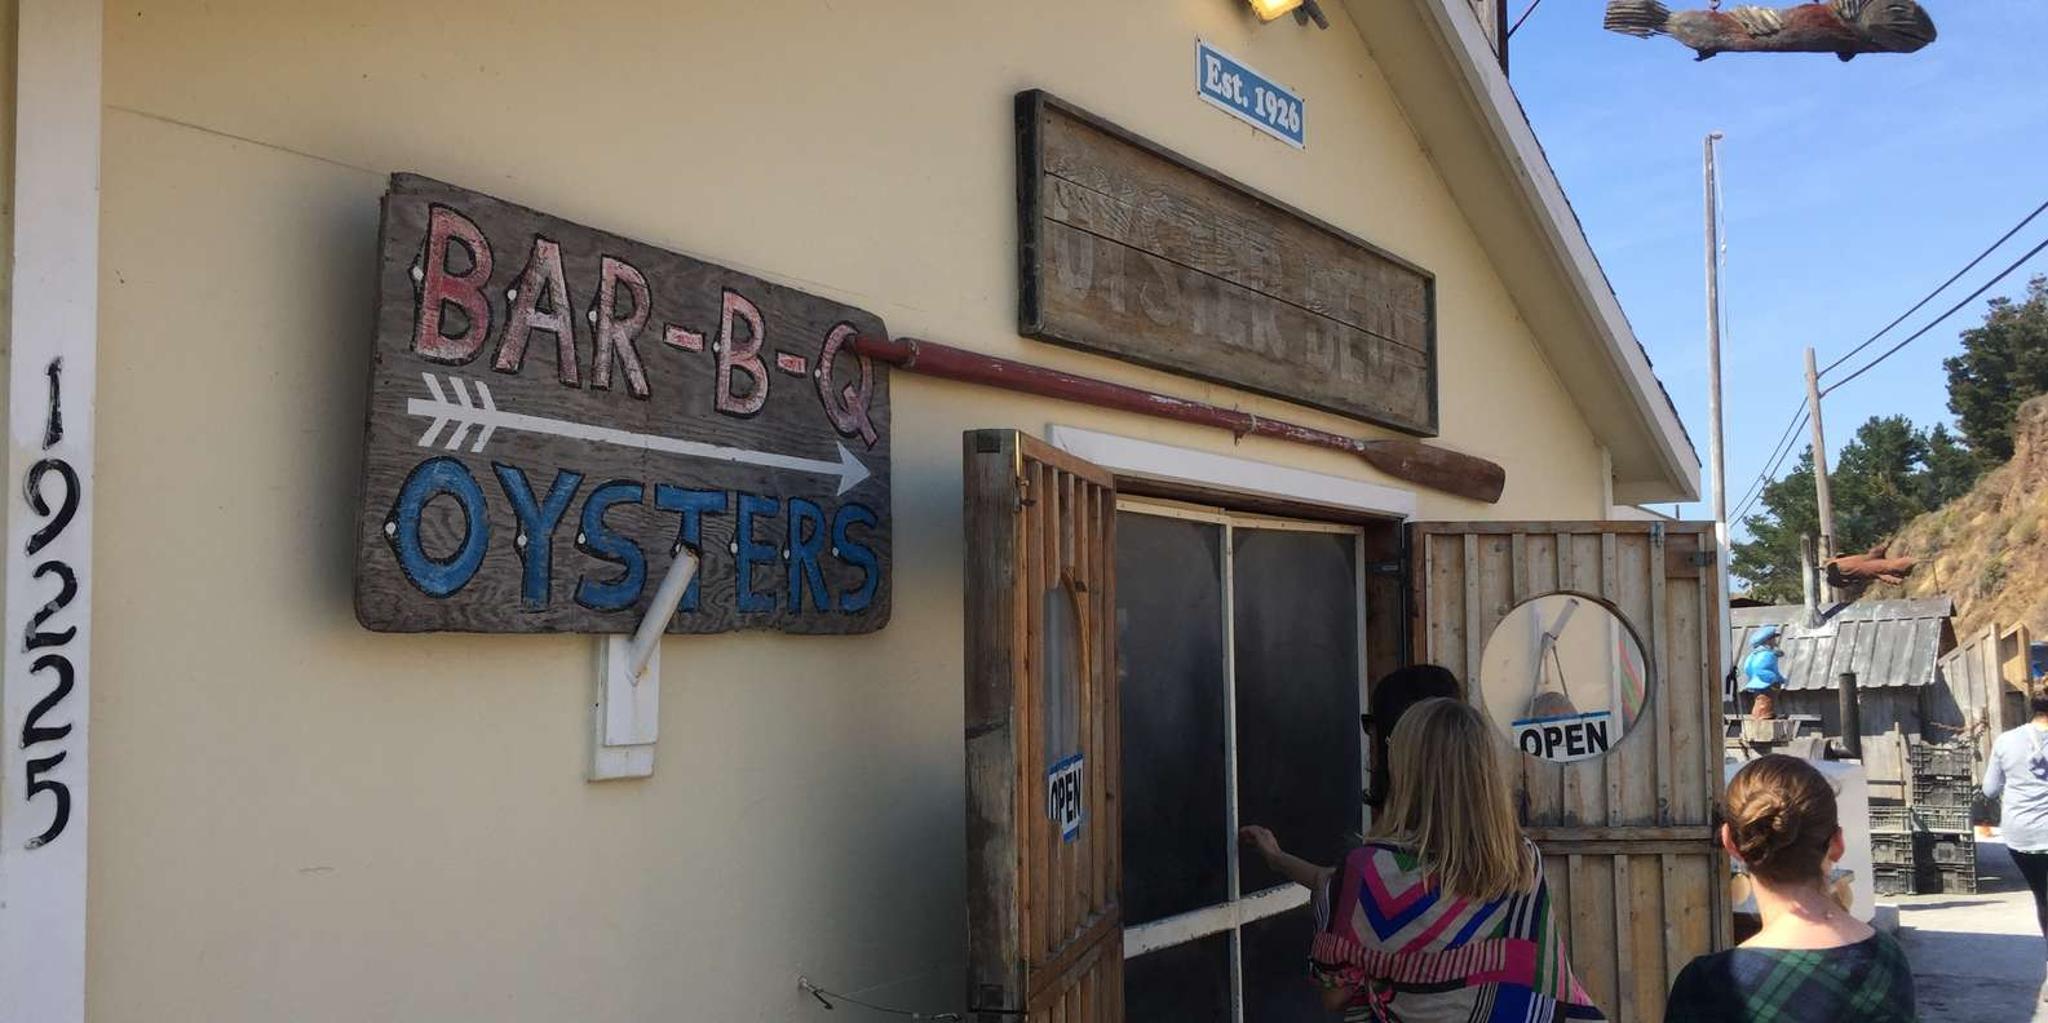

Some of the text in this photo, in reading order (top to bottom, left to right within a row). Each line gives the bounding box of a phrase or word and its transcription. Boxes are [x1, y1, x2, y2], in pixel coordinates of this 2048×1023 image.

[1205, 54, 1300, 133] Est. 1926
[411, 202, 878, 452] BAR-B-Q
[384, 455, 880, 614] OYSTERS
[20, 356, 81, 849] 19225
[1050, 767, 1081, 824] OPEN
[1520, 720, 1609, 759] OPEN
